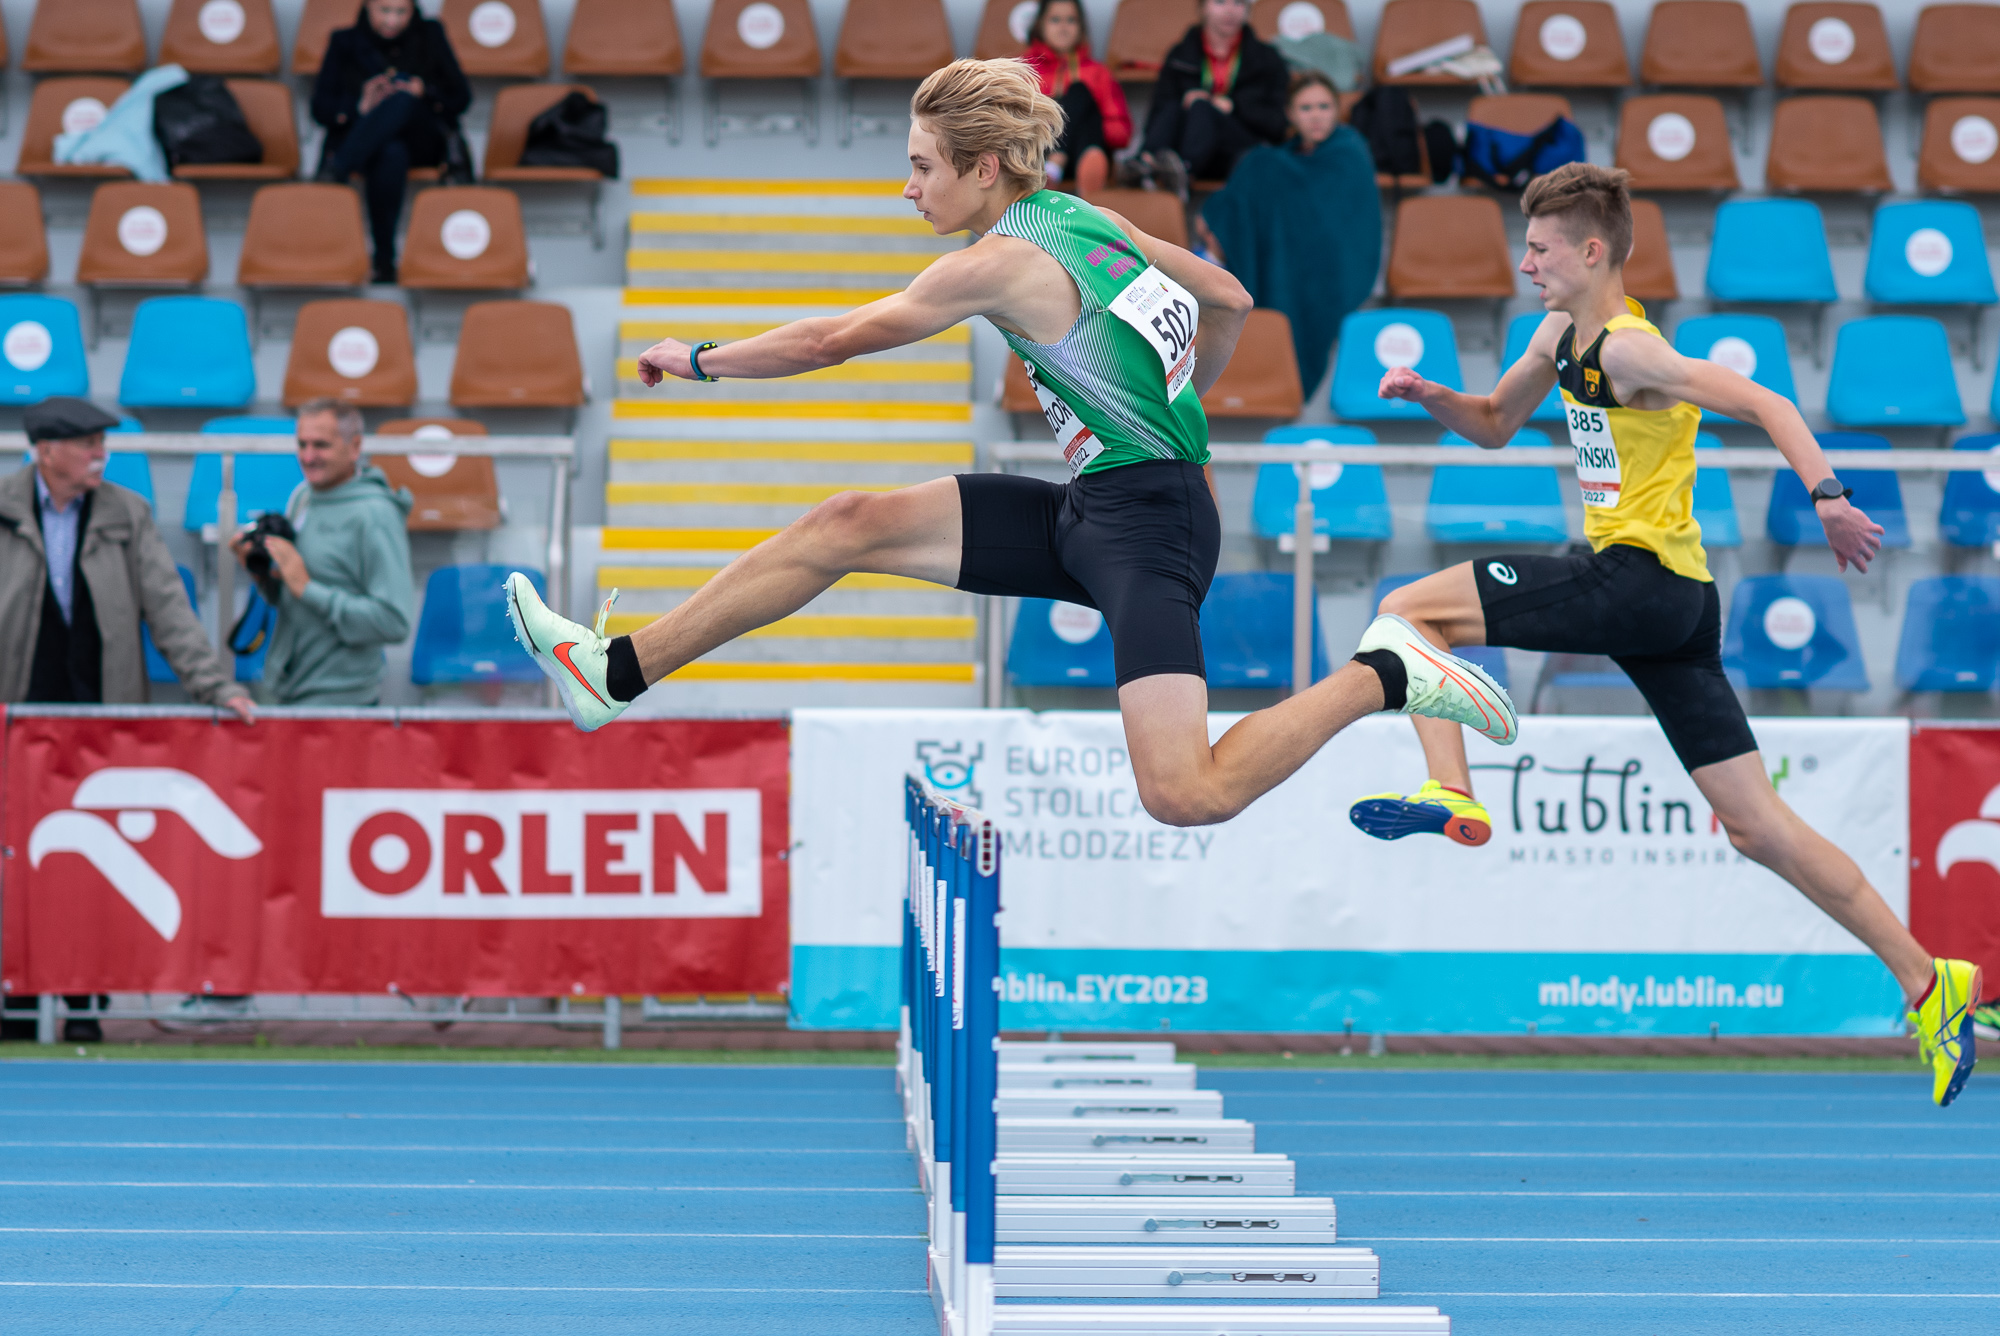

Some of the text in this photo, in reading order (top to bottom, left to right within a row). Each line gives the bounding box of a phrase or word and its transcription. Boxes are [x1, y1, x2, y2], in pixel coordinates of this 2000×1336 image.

[1085, 245, 1109, 266] WKS
[1150, 299, 1193, 361] 502
[1570, 409, 1603, 433] 385
[1583, 490, 1606, 502] 2022
[1006, 746, 1135, 776] EUROP
[348, 810, 730, 896] ORLEN
[1510, 848, 1614, 865] MIASTO
[1537, 975, 1785, 1014] mlody.lublin.eu
